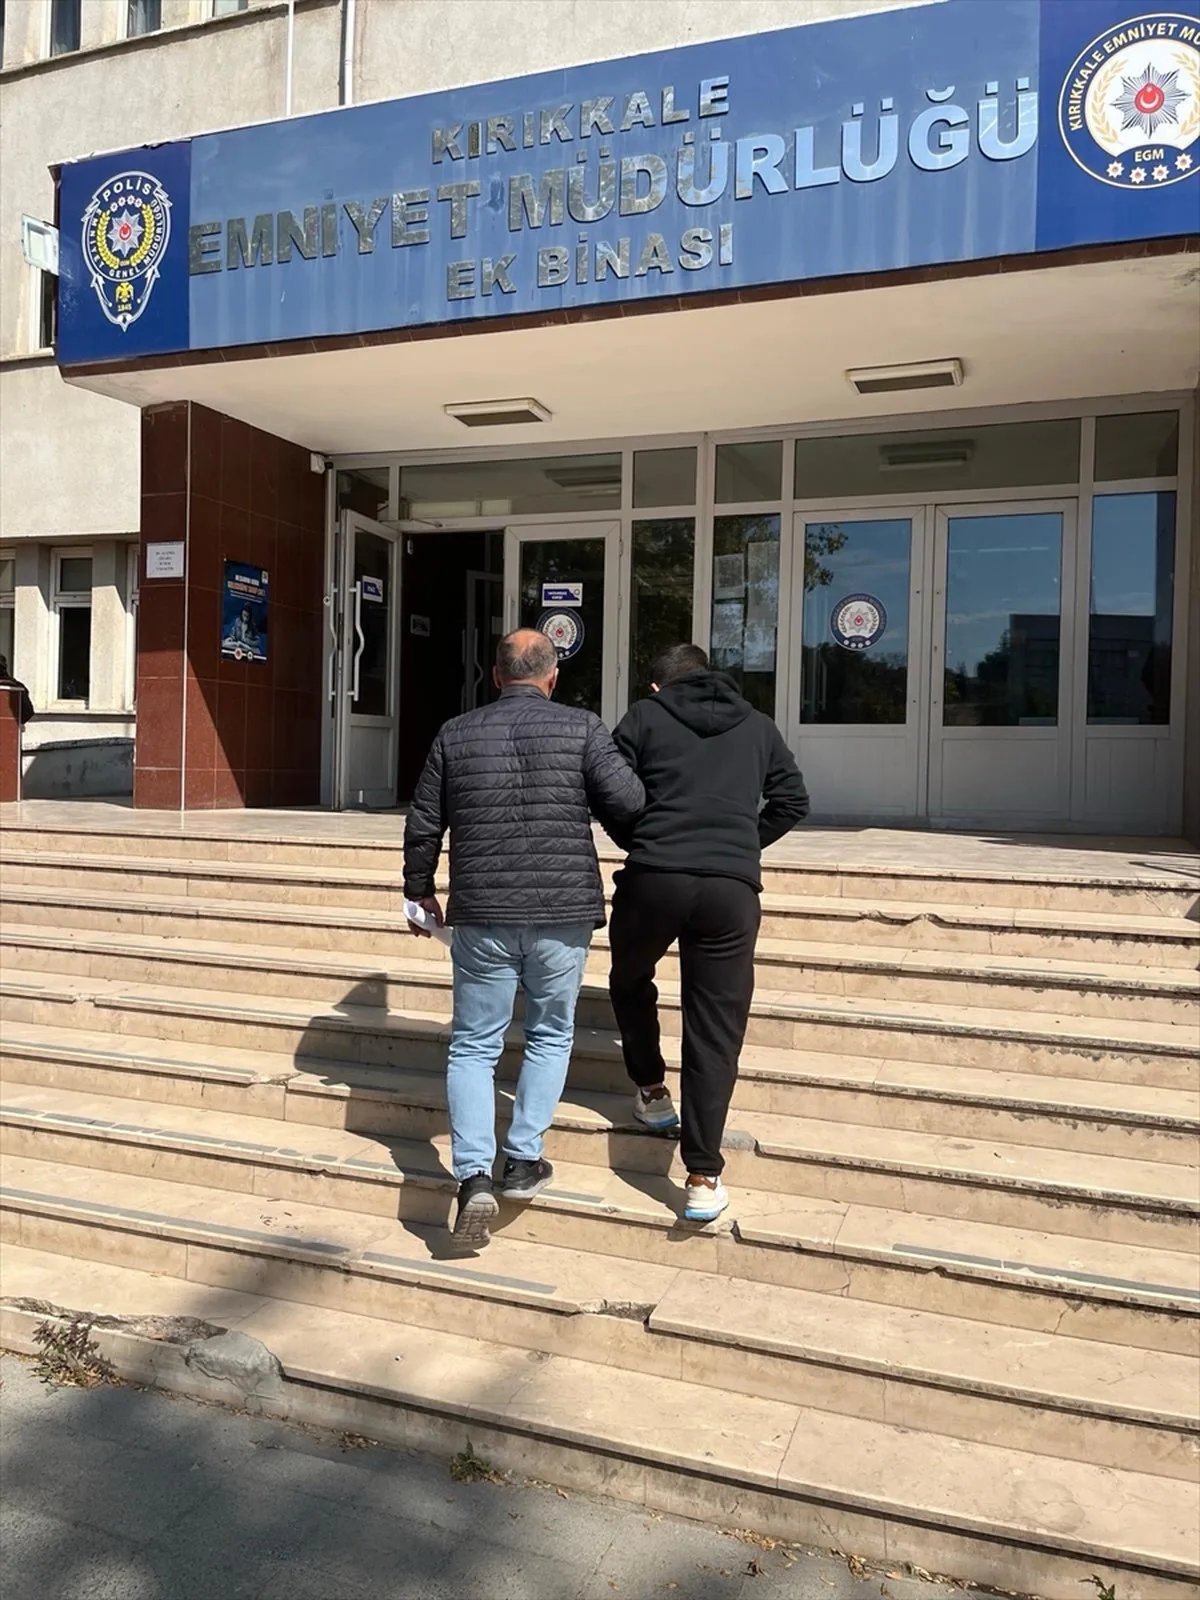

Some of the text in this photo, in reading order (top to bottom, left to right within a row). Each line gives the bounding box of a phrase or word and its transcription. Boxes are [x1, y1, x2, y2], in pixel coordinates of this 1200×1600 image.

[1068, 50, 1105, 132] KIRIKKALE
[1103, 22, 1178, 54] EMNİYET
[432, 75, 730, 165] KIRIKKALE
[508, 76, 1040, 232] MÜDÜRLÜĞÜ
[1134, 149, 1165, 163] EGM
[102, 176, 152, 202] POLİS
[108, 266, 141, 279] GENEL
[447, 223, 734, 302] EK BİNASI
